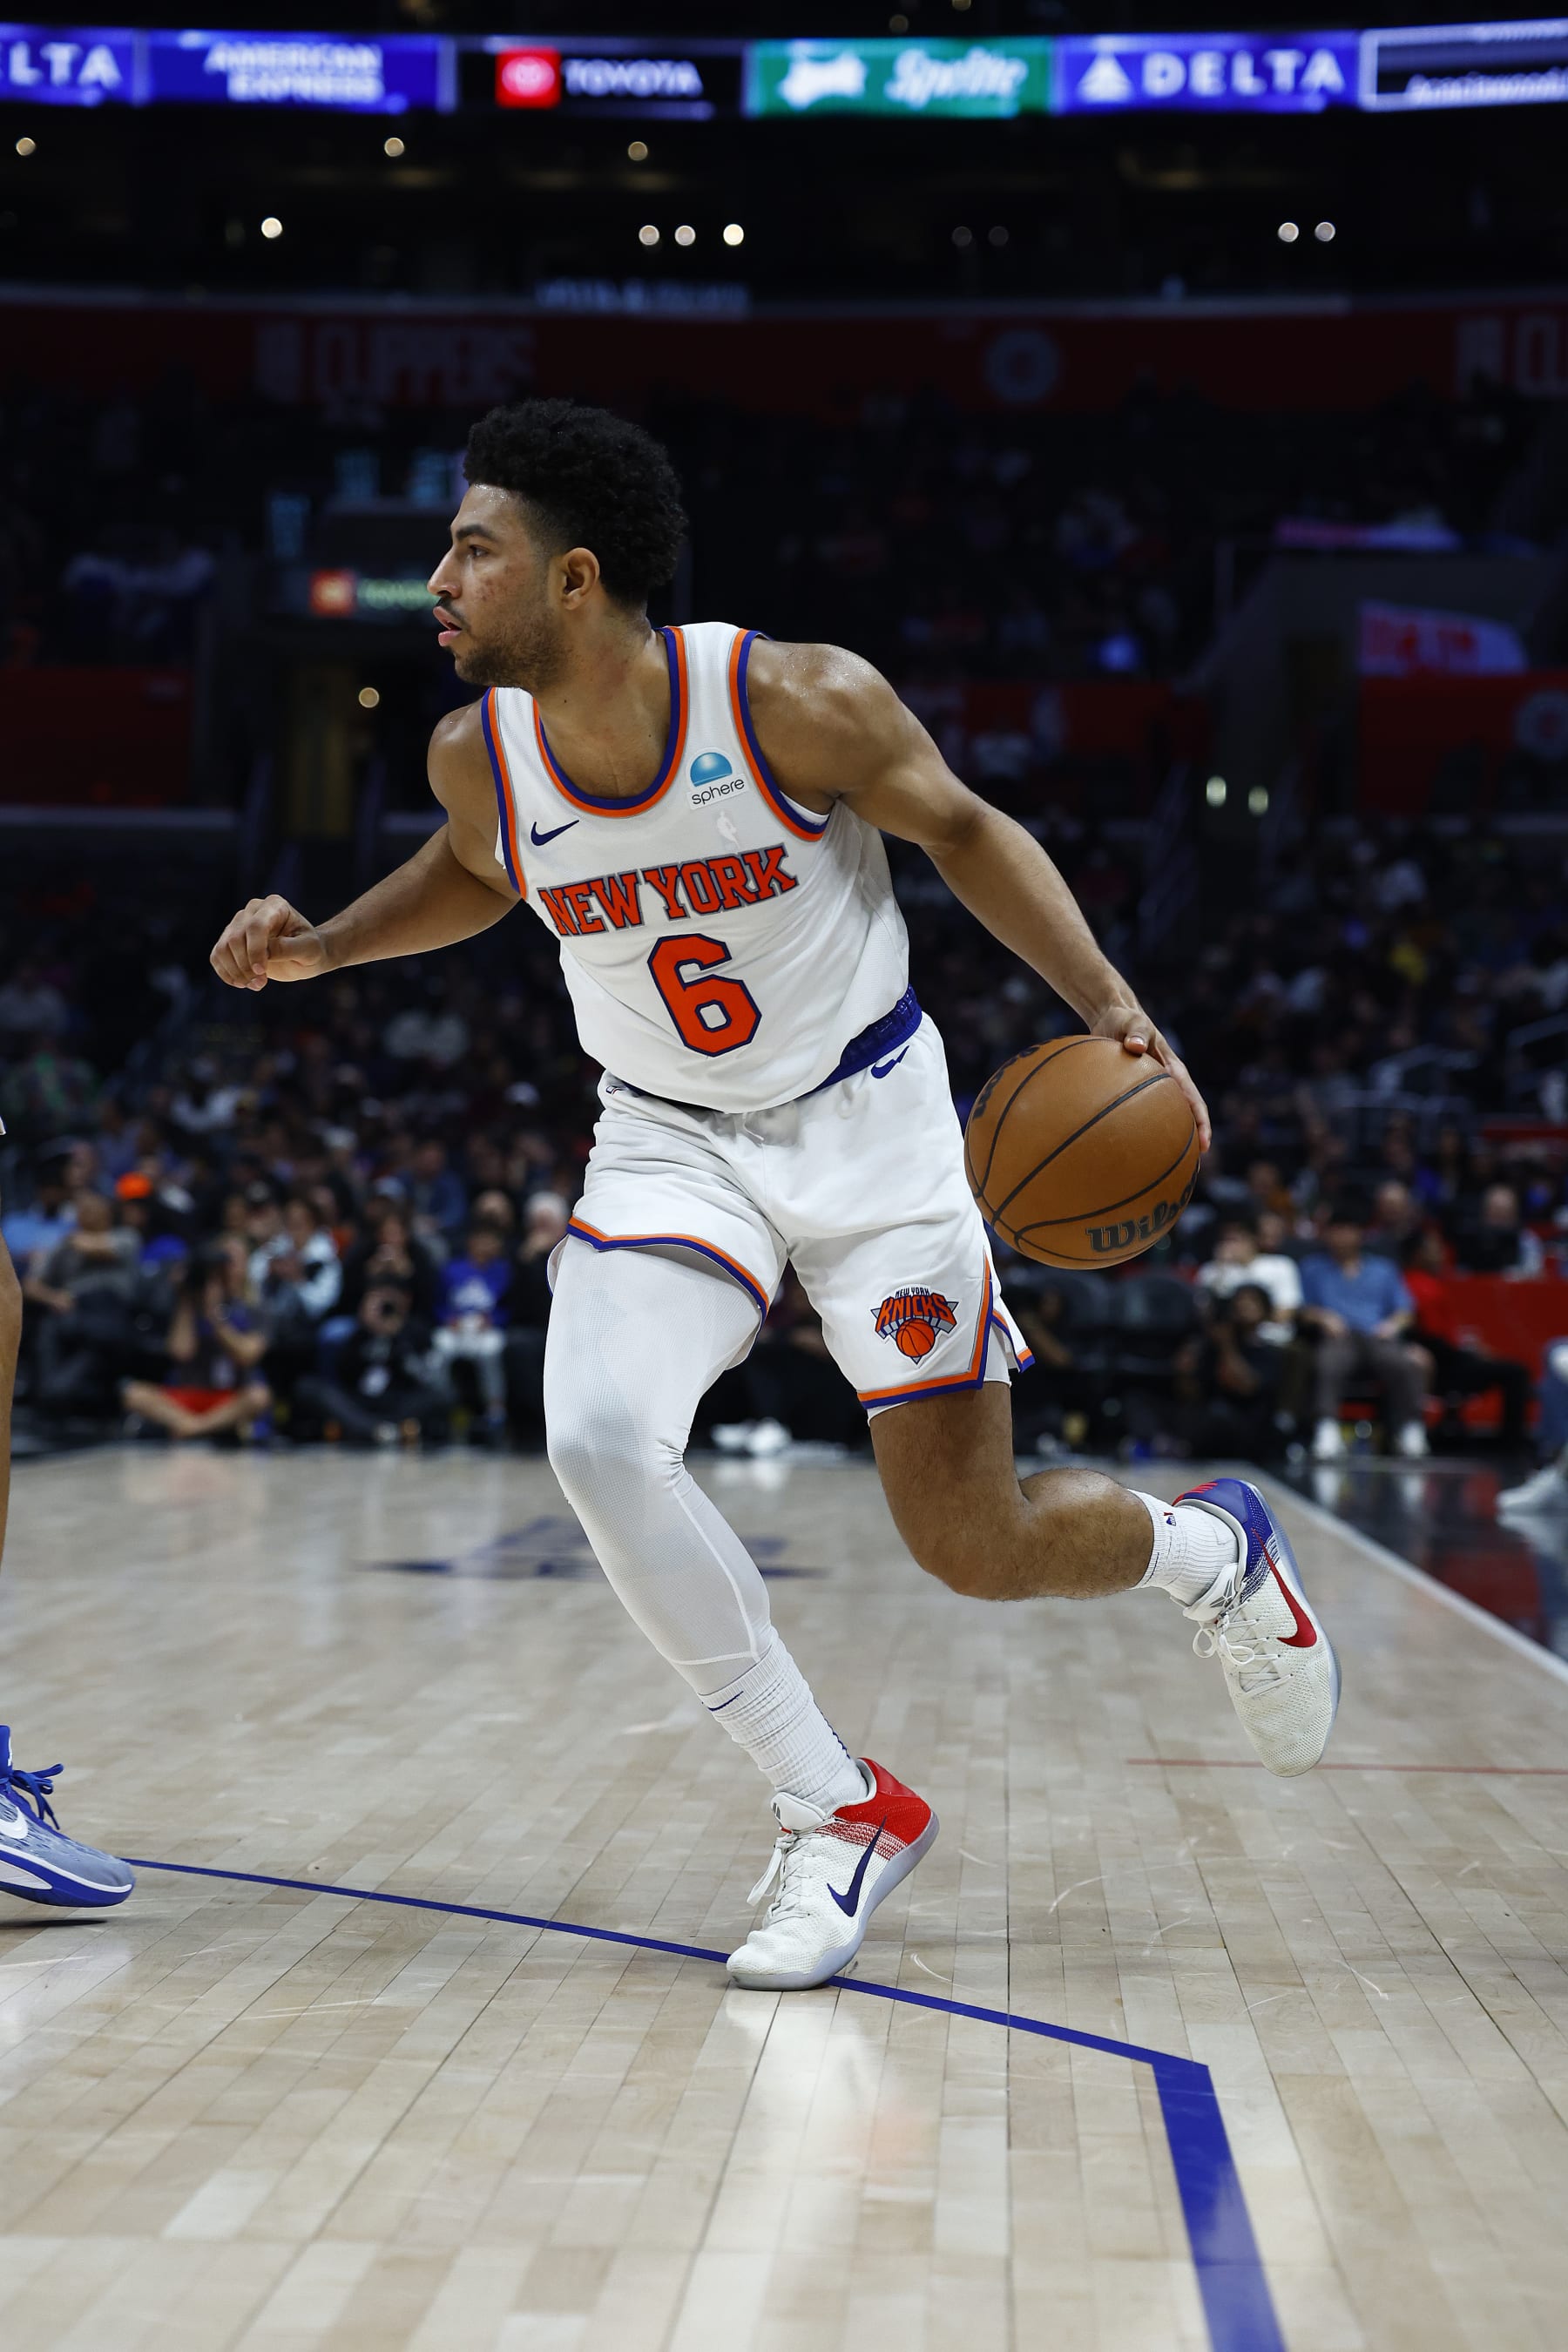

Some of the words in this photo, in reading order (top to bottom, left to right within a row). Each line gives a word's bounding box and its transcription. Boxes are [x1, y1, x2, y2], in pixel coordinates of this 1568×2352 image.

[0, 41, 122, 89] LTA
[562, 58, 703, 98] TOYOTA
[884, 47, 1028, 111] Sprite
[1143, 49, 1346, 98] DELTA
[692, 779, 745, 805] sphere
[537, 872, 645, 936] NEW
[640, 842, 799, 921] YORK
[647, 933, 762, 1058] 6
[875, 1293, 957, 1335] KNICKS
[895, 1288, 911, 1299] NEW
[910, 1287, 930, 1297] YORK
